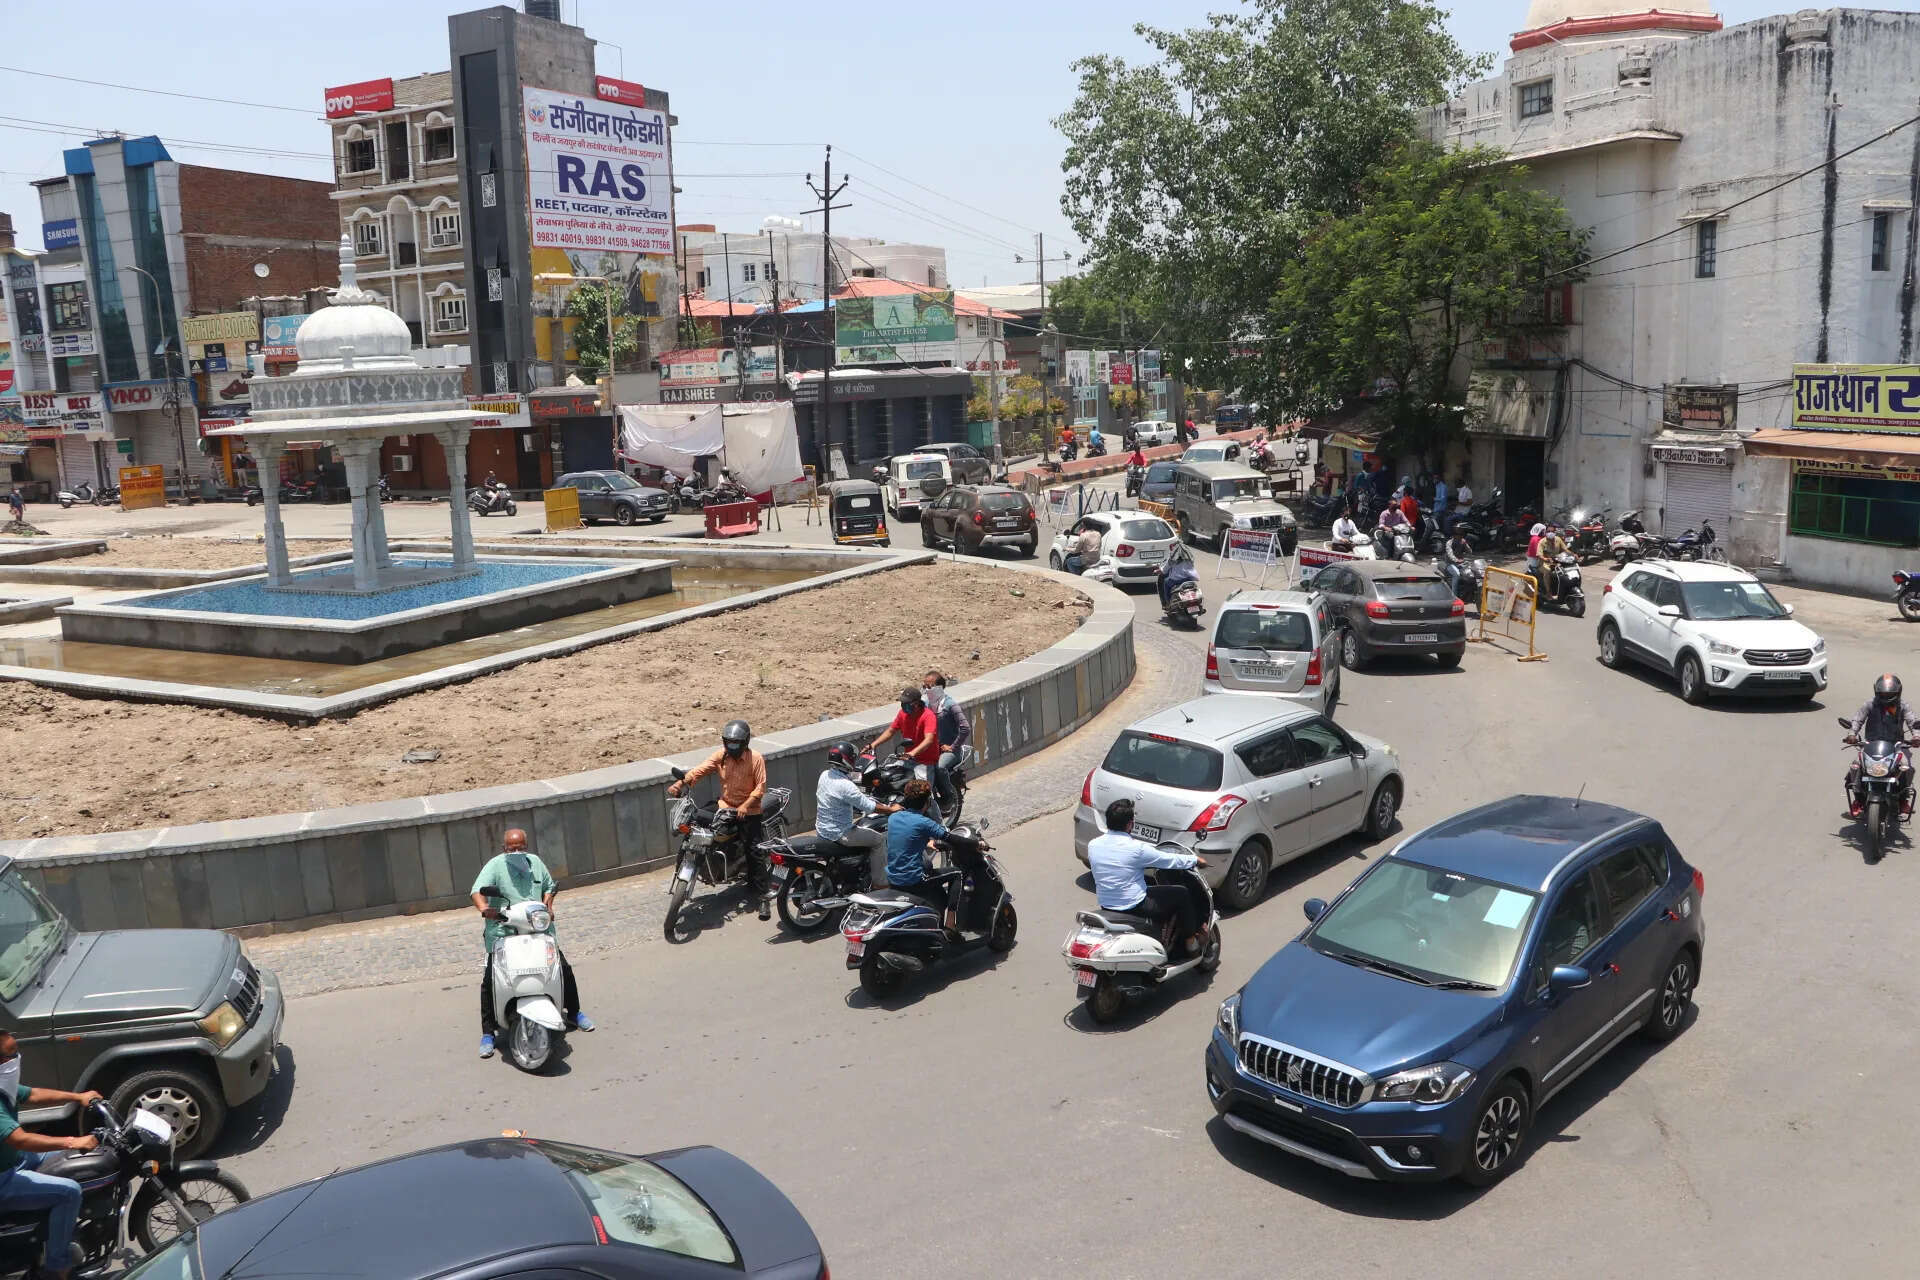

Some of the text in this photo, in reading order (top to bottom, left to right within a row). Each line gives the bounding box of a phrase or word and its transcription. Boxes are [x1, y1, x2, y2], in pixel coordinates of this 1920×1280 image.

[599, 83, 620, 98] OYO
[326, 95, 353, 112] OYO
[548, 100, 664, 146] संजीवन एकेडमी
[557, 154, 646, 201] RAS
[535, 198, 569, 213] REET,
[46, 227, 79, 240] SAMSUN
[536, 231, 558, 243] 99831
[585, 235, 606, 245] 99831
[885, 305, 901, 326] A
[184, 317, 223, 341] BATHIJA
[226, 313, 258, 338] BOOTS
[862, 326, 928, 338] THE ARTIST HOUSE
[23, 394, 55, 409] BEST
[109, 386, 151, 405] VINOD
[663, 387, 716, 402] RAJ SHREE
[1795, 374, 1882, 414] राजस्थान
